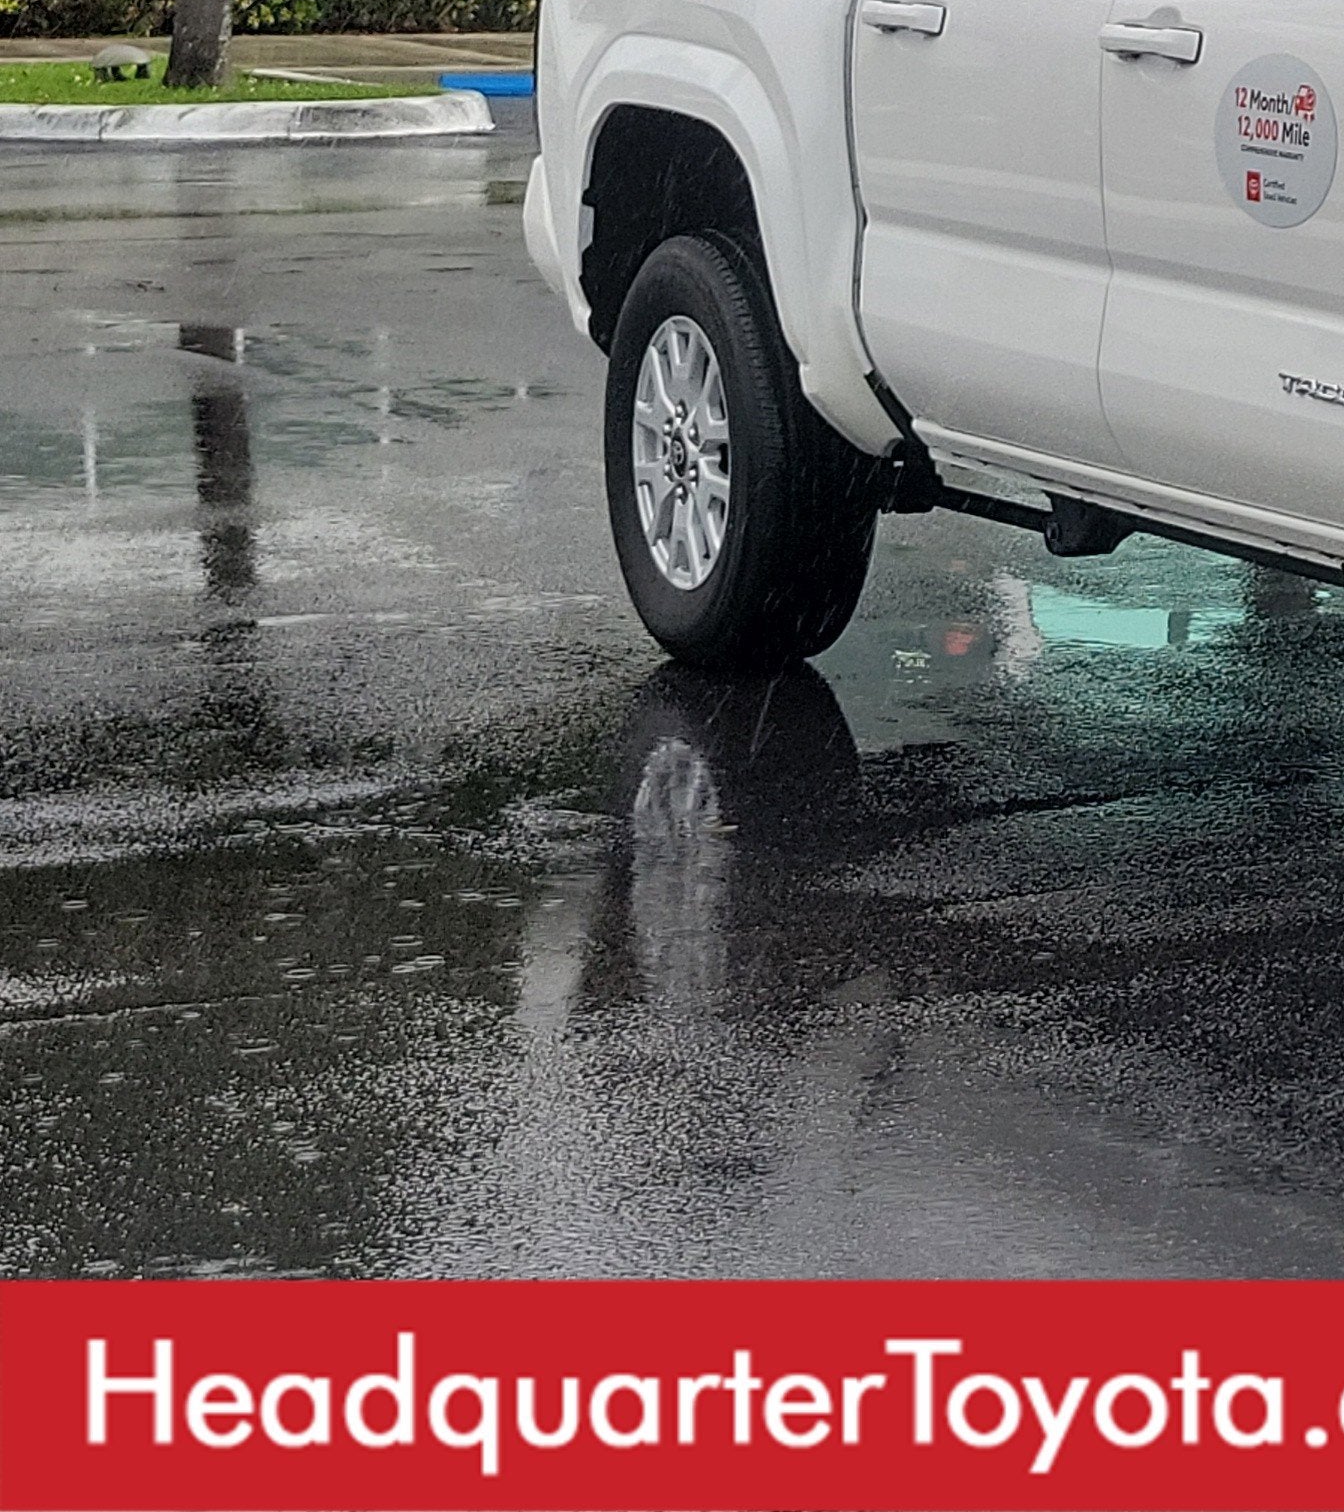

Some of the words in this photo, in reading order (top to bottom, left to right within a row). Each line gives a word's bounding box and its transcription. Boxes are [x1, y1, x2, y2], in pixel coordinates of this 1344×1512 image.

[1235, 86, 1248, 108] 12
[1238, 115, 1279, 141] 12,000
[1281, 121, 1310, 147] Mile
